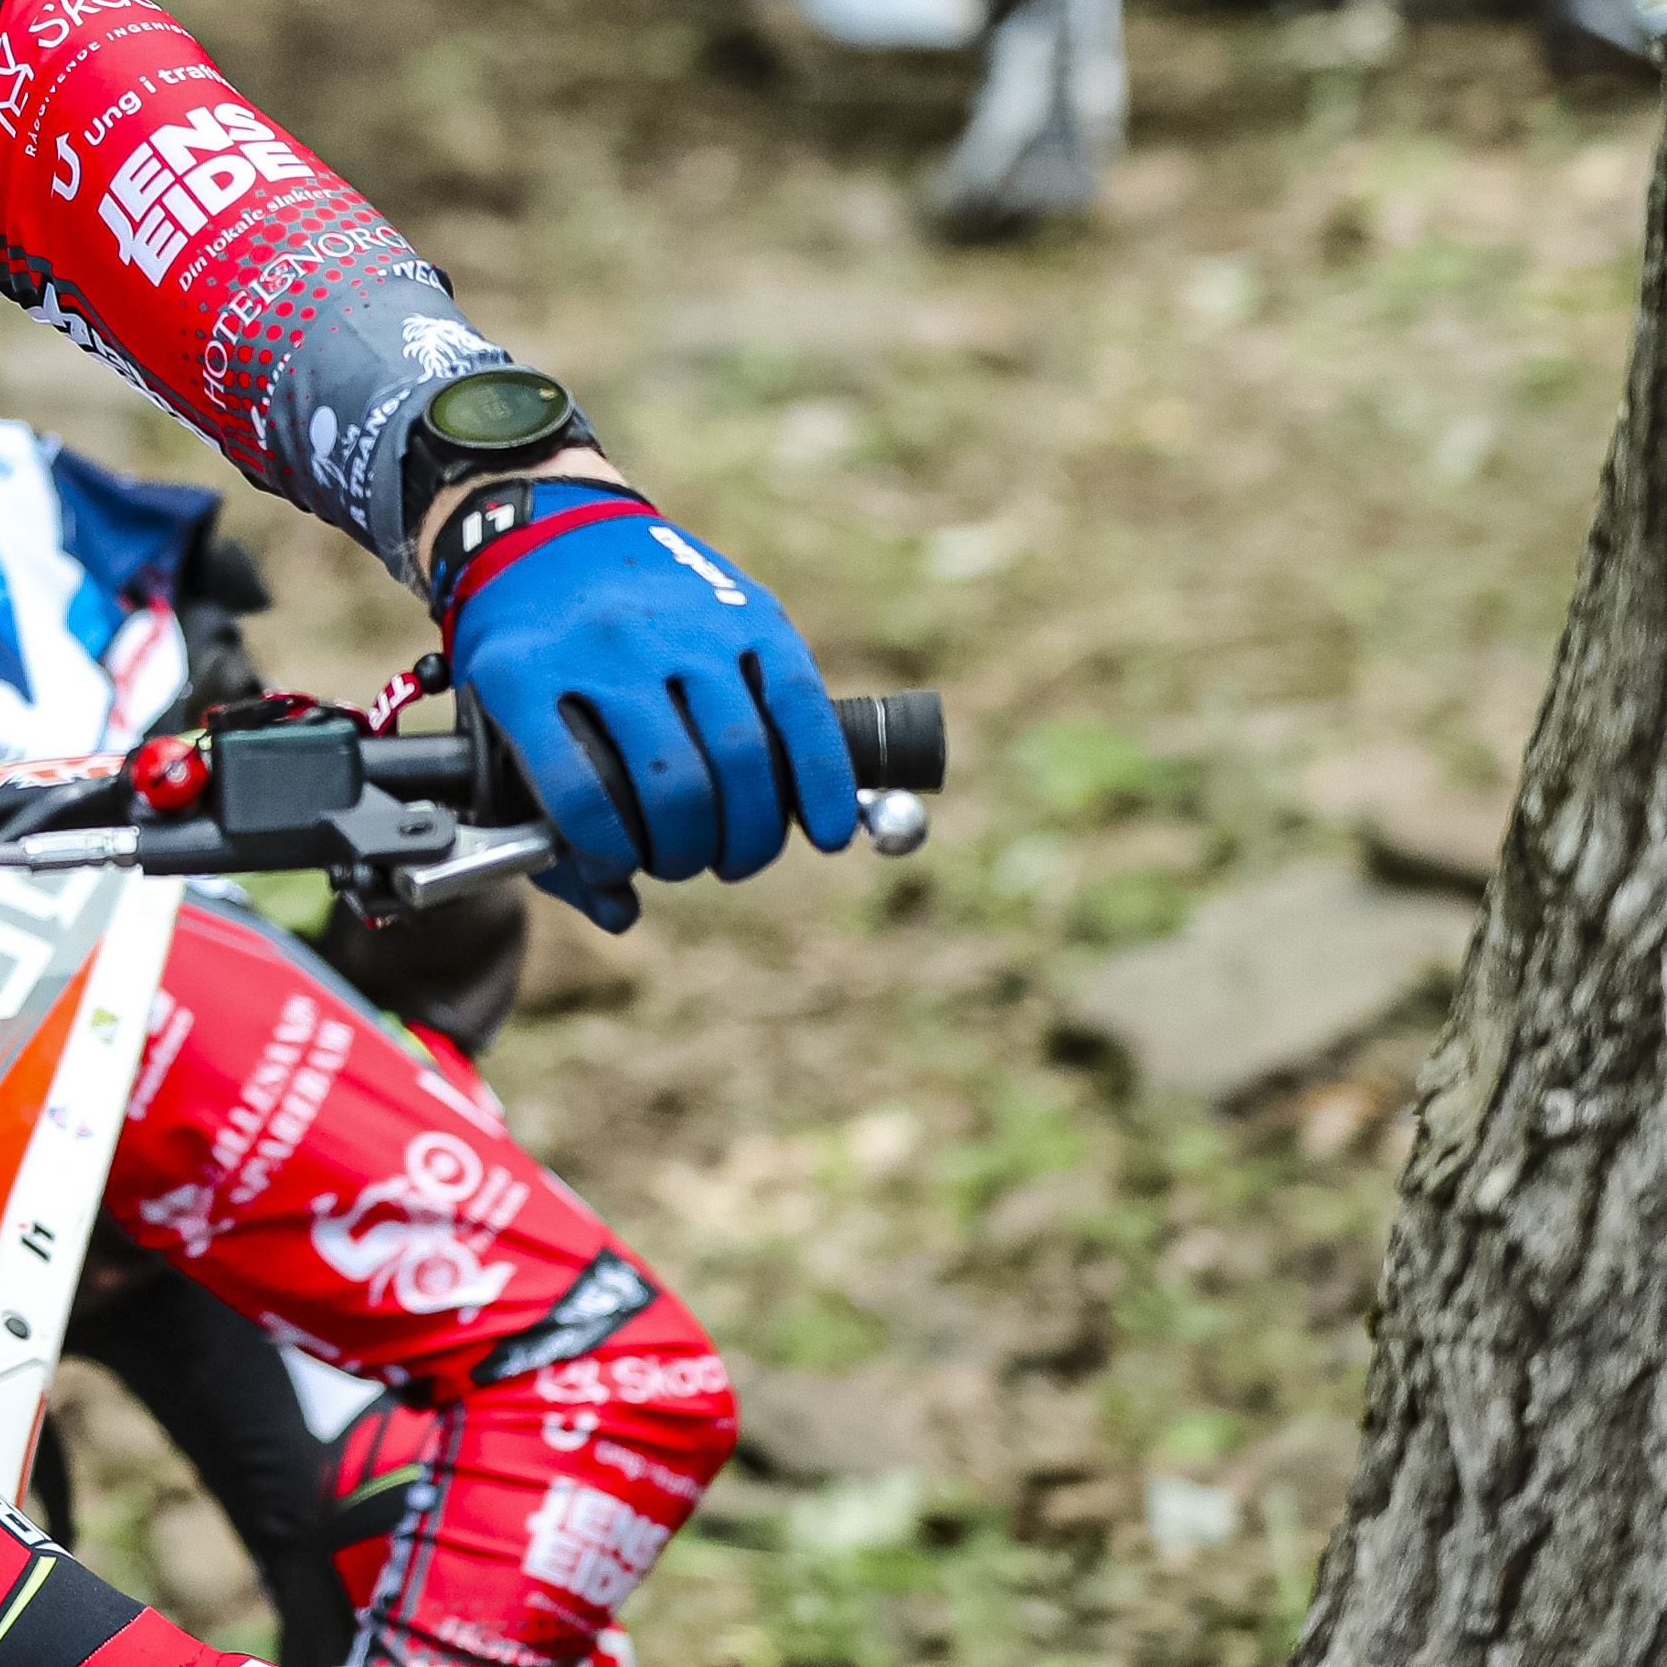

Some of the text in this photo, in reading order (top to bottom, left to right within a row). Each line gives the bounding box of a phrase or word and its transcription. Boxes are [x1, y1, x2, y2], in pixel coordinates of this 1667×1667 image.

[83, 89, 143, 146] Ung
[139, 75, 157, 94] i
[97, 101, 277, 266] JENS
[131, 140, 317, 288] EIDE
[178, 187, 333, 292] Din lokale slakter
[202, 278, 283, 411] HOTEL
